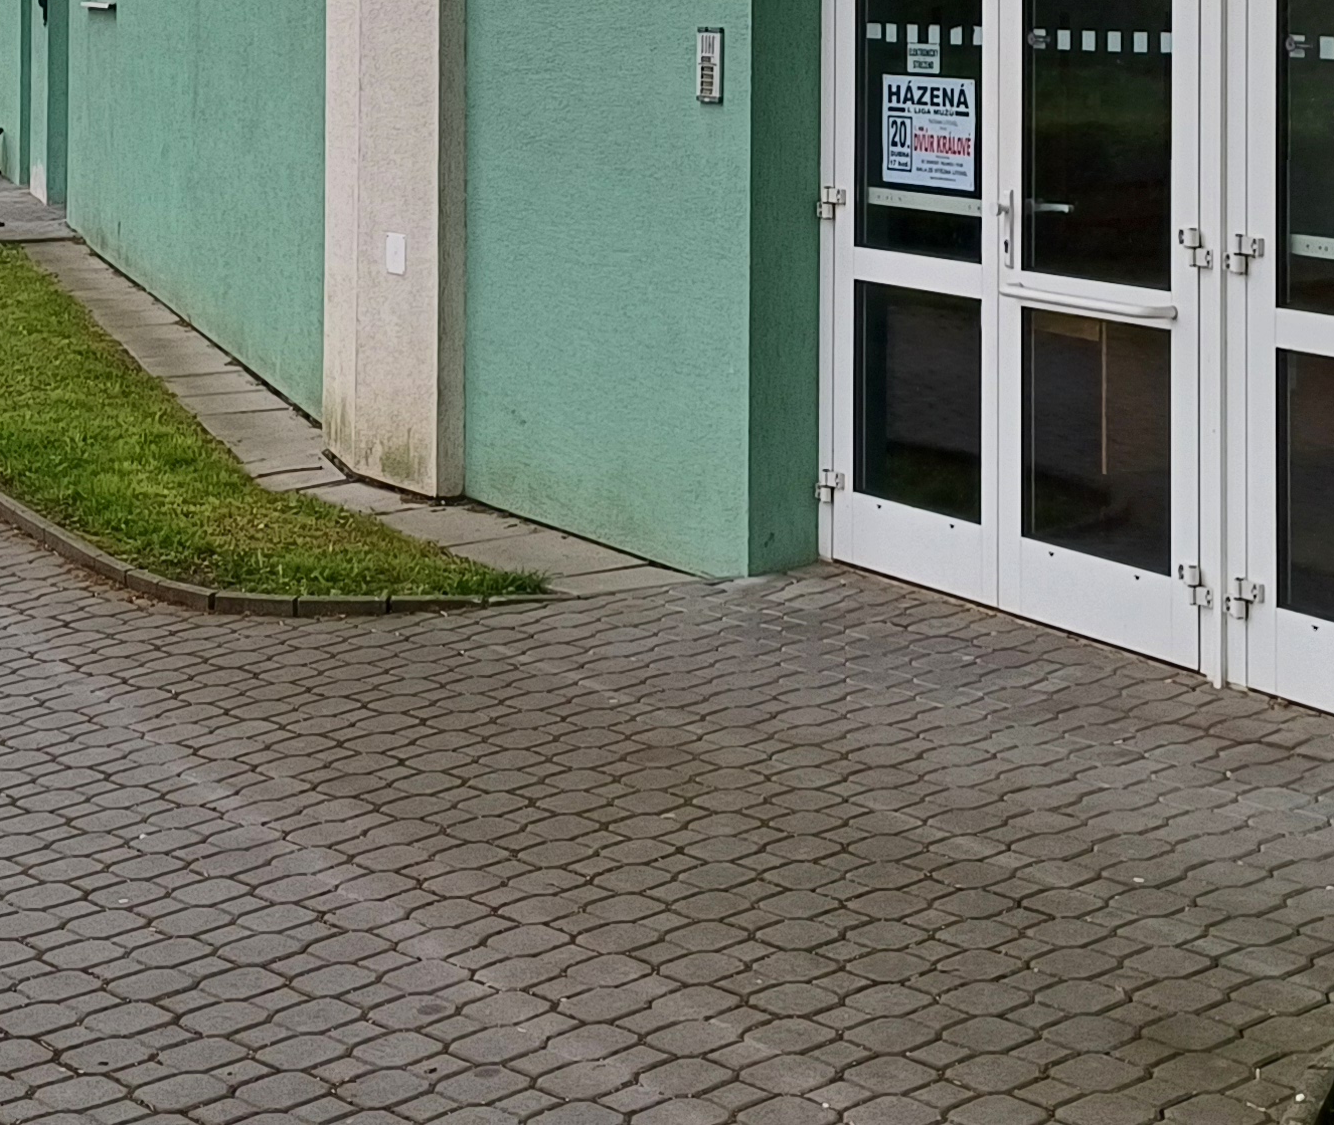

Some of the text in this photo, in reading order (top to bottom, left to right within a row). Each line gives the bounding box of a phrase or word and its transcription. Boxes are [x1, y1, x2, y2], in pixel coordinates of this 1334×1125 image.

[887, 80, 969, 109] HÁZENÁ
[914, 107, 931, 115] LIGA
[890, 119, 910, 149] 20.
[937, 132, 971, 157] KRÁLOVÉ
